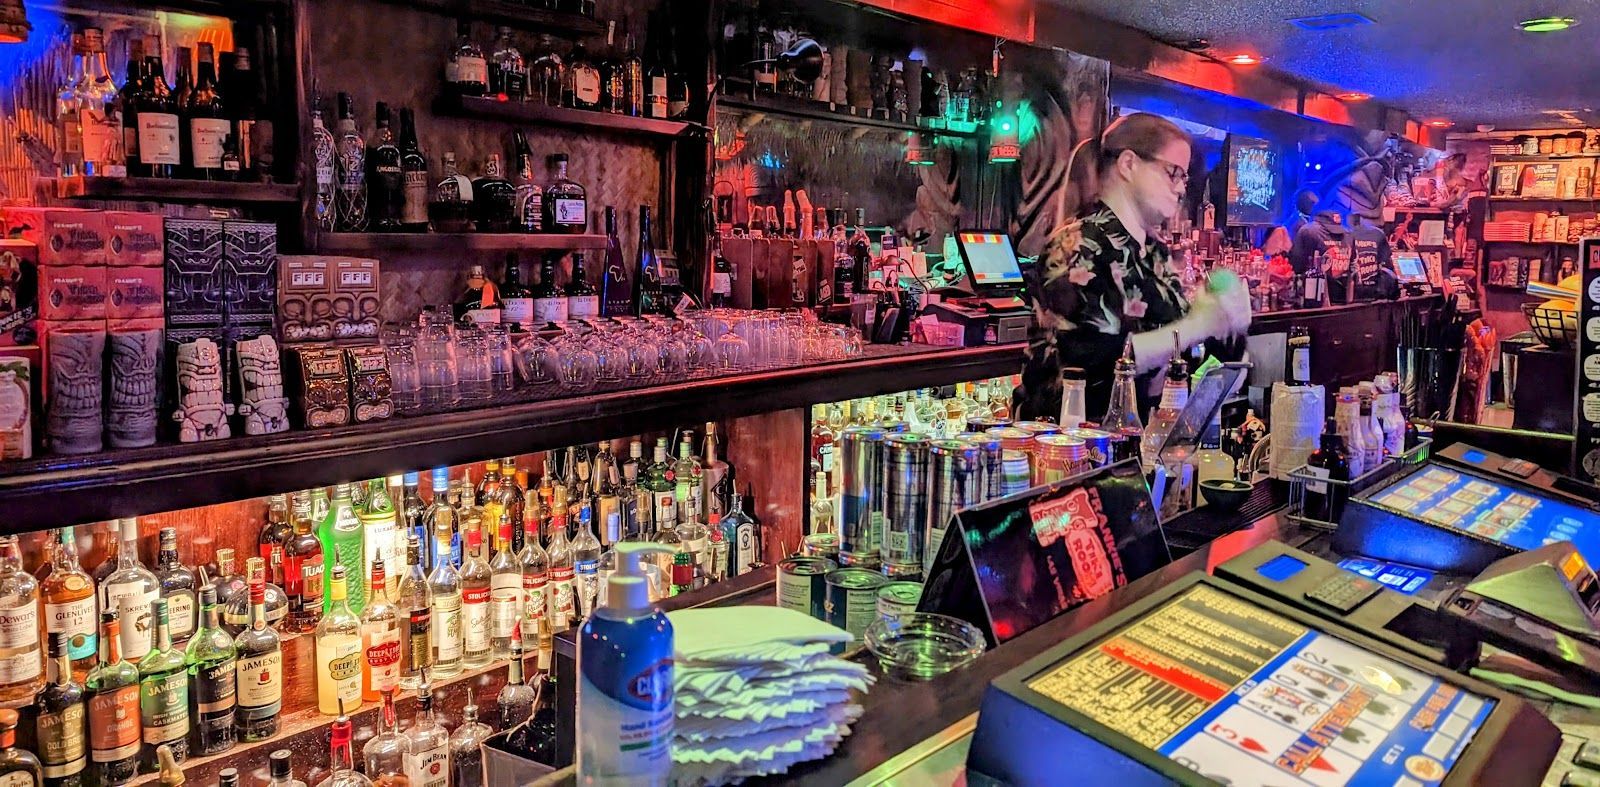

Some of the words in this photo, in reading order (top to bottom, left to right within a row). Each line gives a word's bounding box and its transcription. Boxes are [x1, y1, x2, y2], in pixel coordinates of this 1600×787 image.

[1088, 486, 1128, 587] FRANKIE'S
[1087, 538, 1103, 579] TIKI
[55, 605, 94, 621] GLENLIVET
[73, 616, 83, 626] 12
[242, 655, 280, 672] JAMESON
[148, 677, 188, 697] JAMESON
[94, 691, 139, 711] JAMESON
[1274, 740, 1324, 777] CALL
[1306, 683, 1378, 747] ATTENDANT
